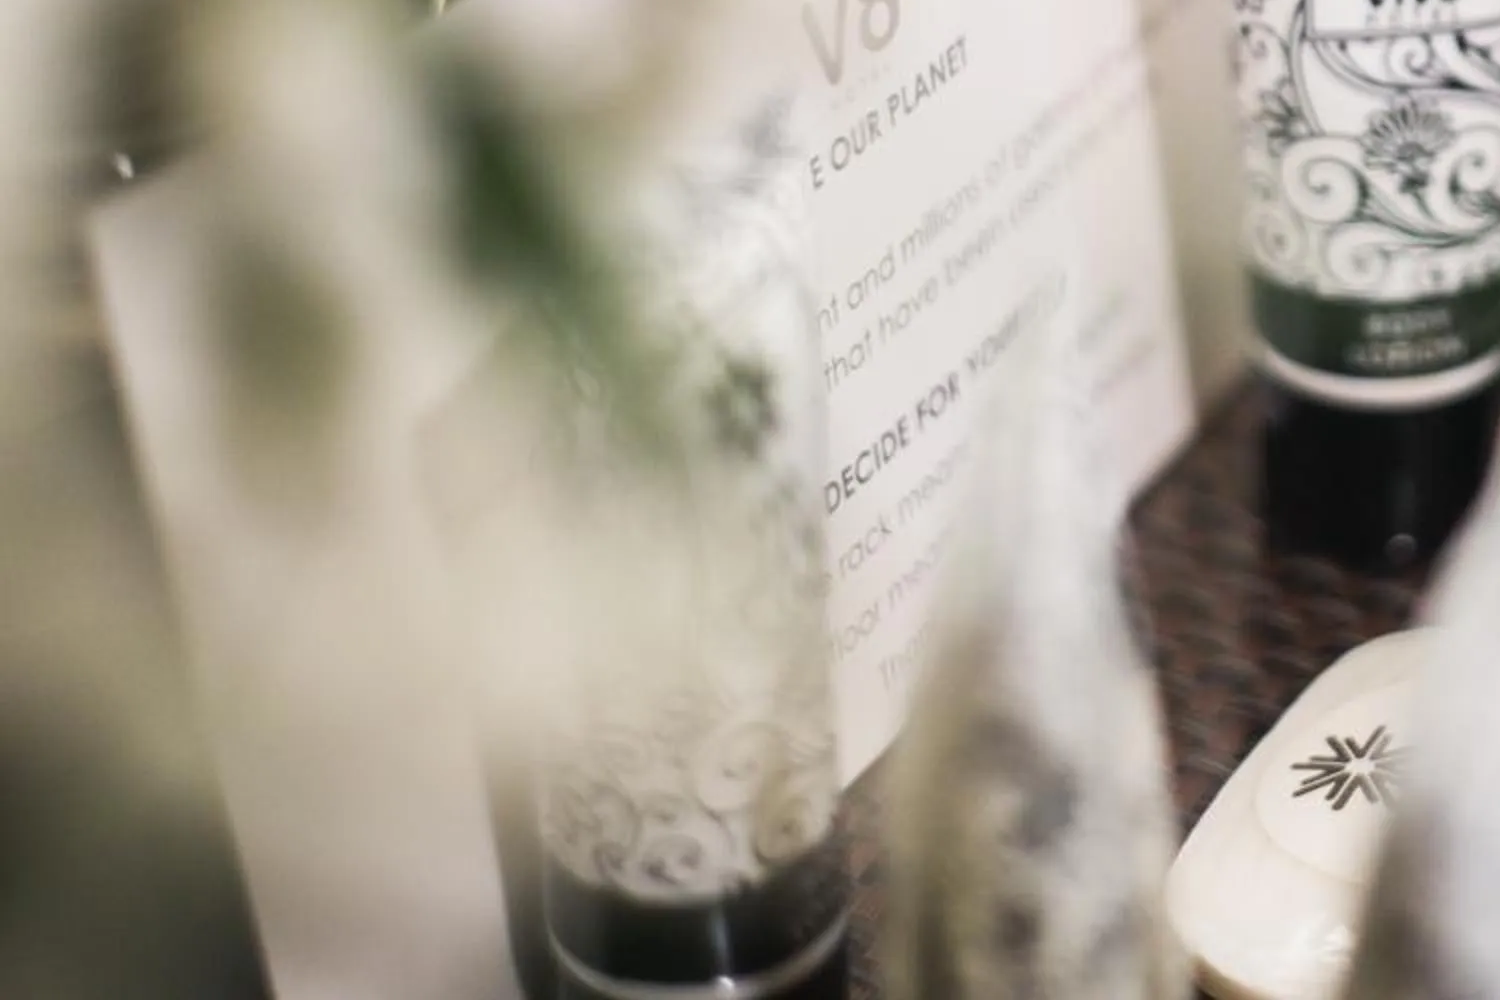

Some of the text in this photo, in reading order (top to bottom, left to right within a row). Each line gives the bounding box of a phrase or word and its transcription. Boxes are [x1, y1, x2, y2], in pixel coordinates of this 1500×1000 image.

[830, 110, 883, 172] OUR
[886, 35, 968, 128] PLANET
[823, 331, 873, 393] that
[878, 276, 940, 346] have
[846, 247, 897, 310] and
[823, 416, 910, 515] DECIDE
[914, 371, 960, 431] FOR
[838, 512, 893, 582] rack
